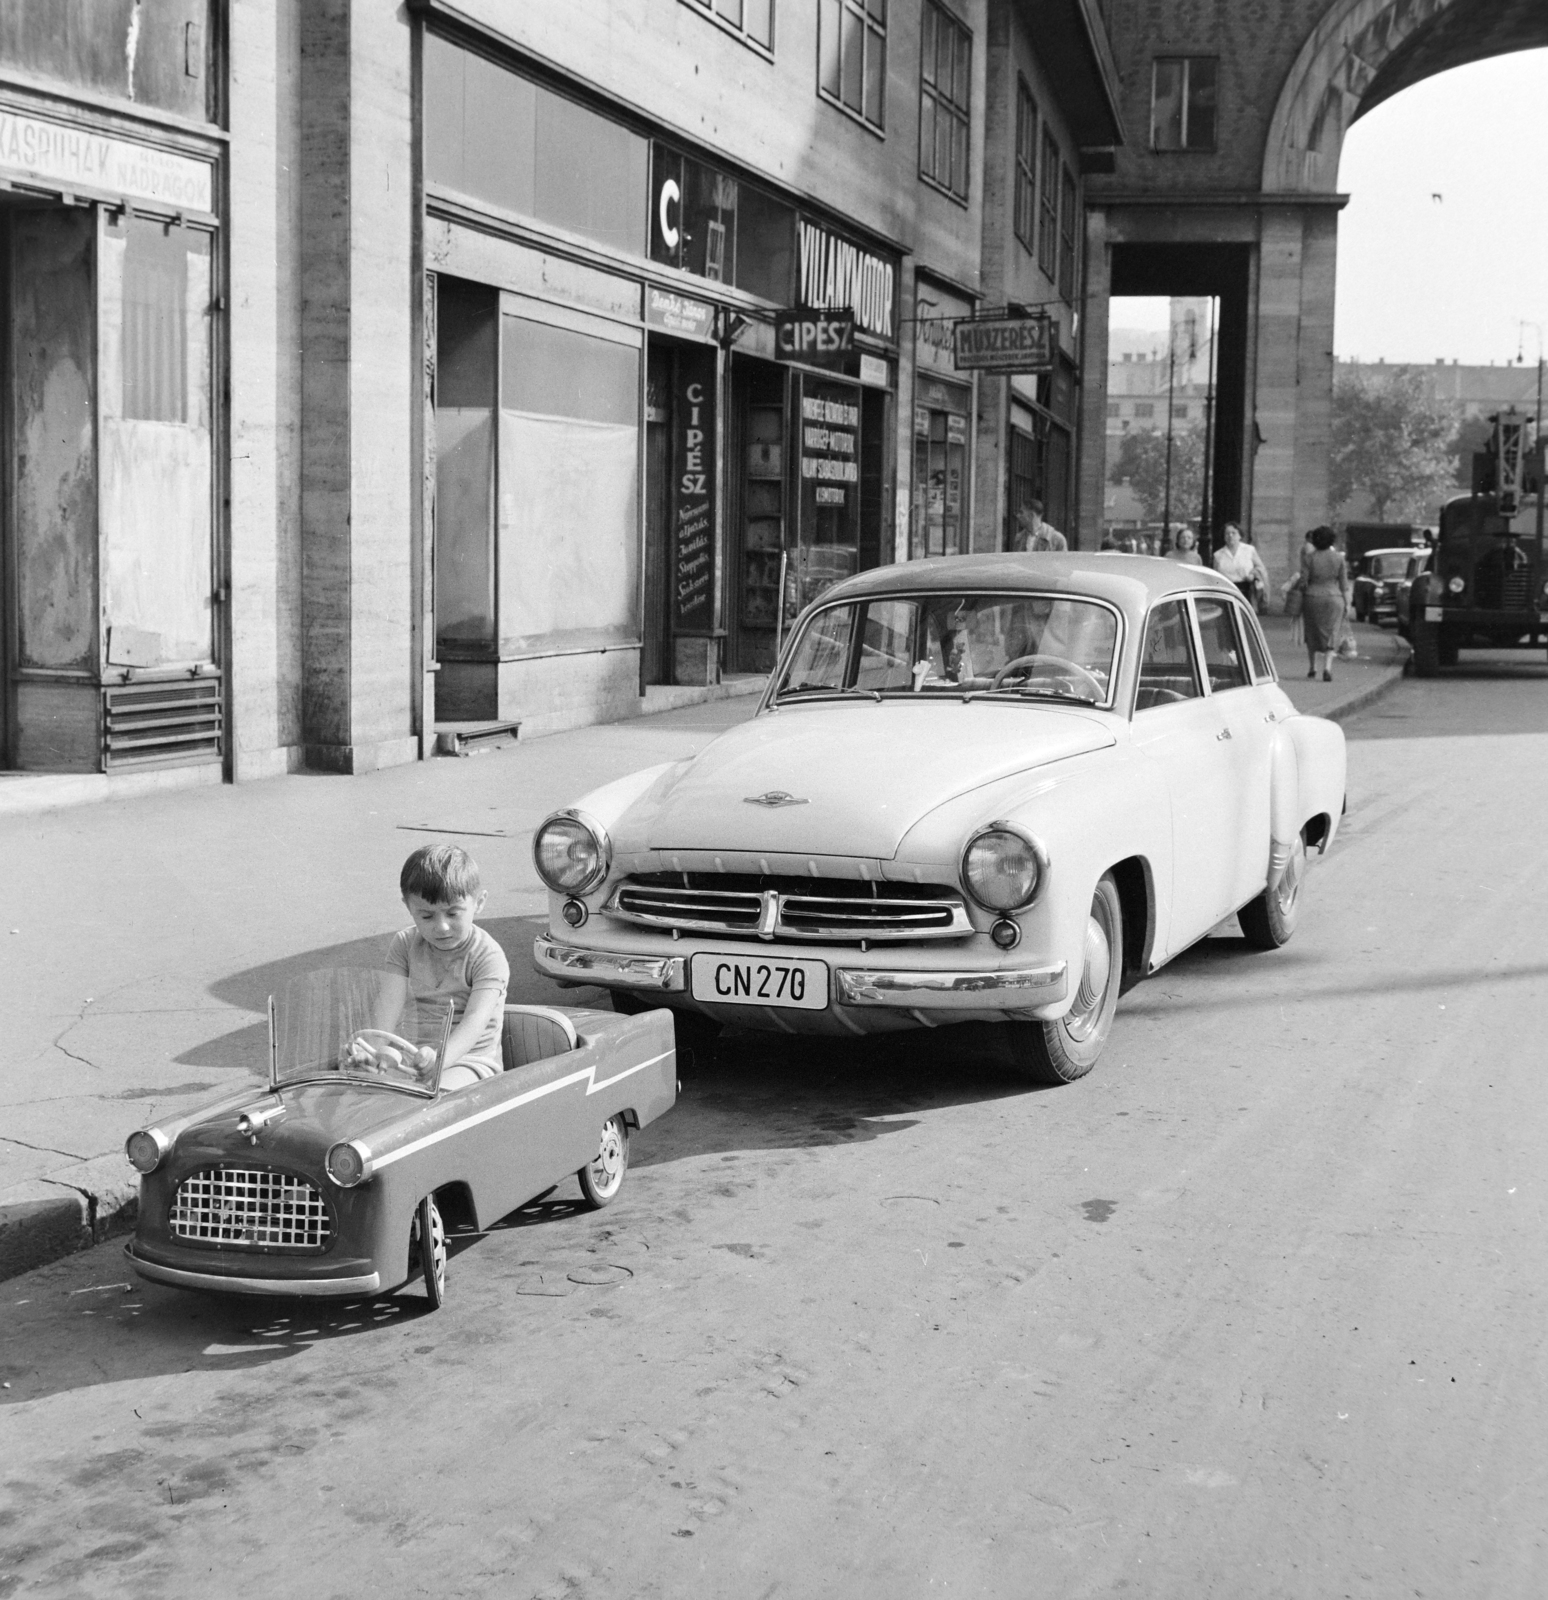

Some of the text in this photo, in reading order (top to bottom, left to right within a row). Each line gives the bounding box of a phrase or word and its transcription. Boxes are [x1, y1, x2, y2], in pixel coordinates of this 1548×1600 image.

[660, 179, 680, 248] C
[800, 221, 894, 337] VILLANYMOTOR
[779, 314, 853, 352] CIPÉSZ
[715, 963, 805, 1001] CN270
